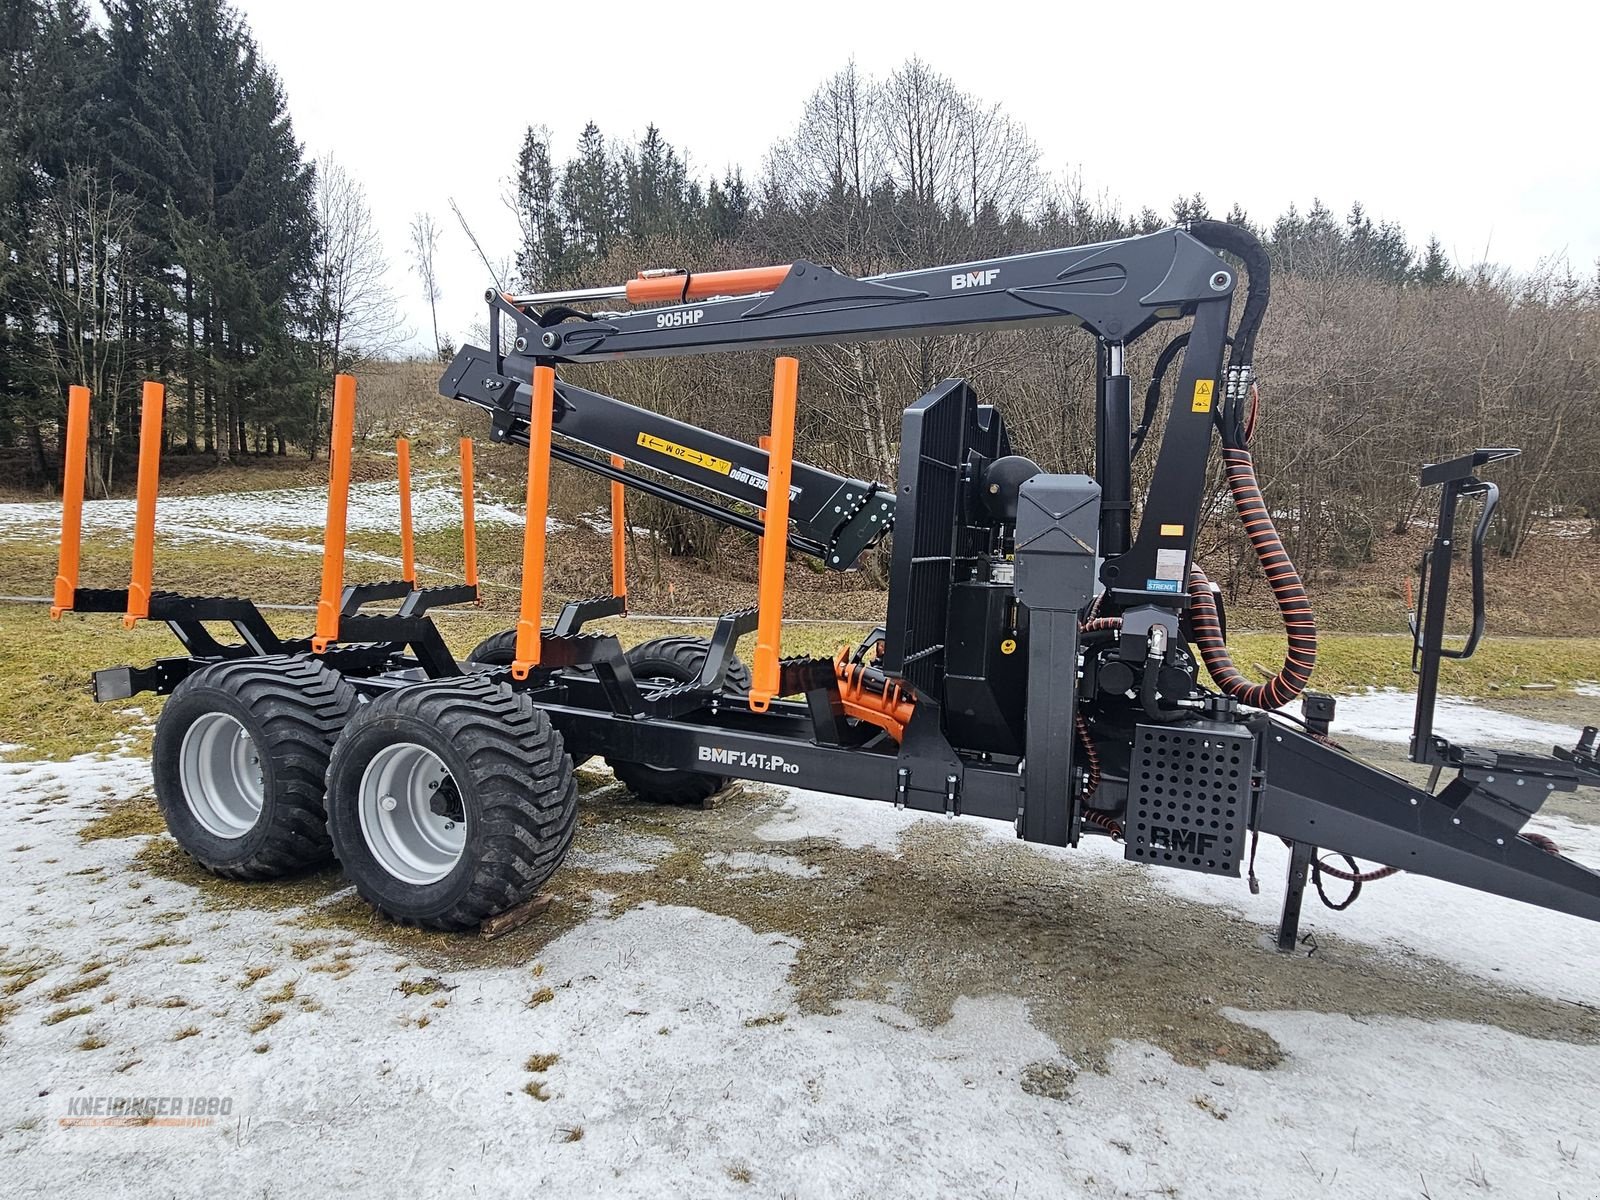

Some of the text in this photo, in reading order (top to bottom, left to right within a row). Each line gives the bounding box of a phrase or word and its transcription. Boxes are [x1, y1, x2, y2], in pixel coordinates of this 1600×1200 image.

[951, 269, 1000, 290] BMF
[656, 310, 704, 328] 905HP
[666, 444, 685, 457] 20 M
[1147, 582, 1176, 591] STRENX
[1149, 825, 1218, 856] BMF
